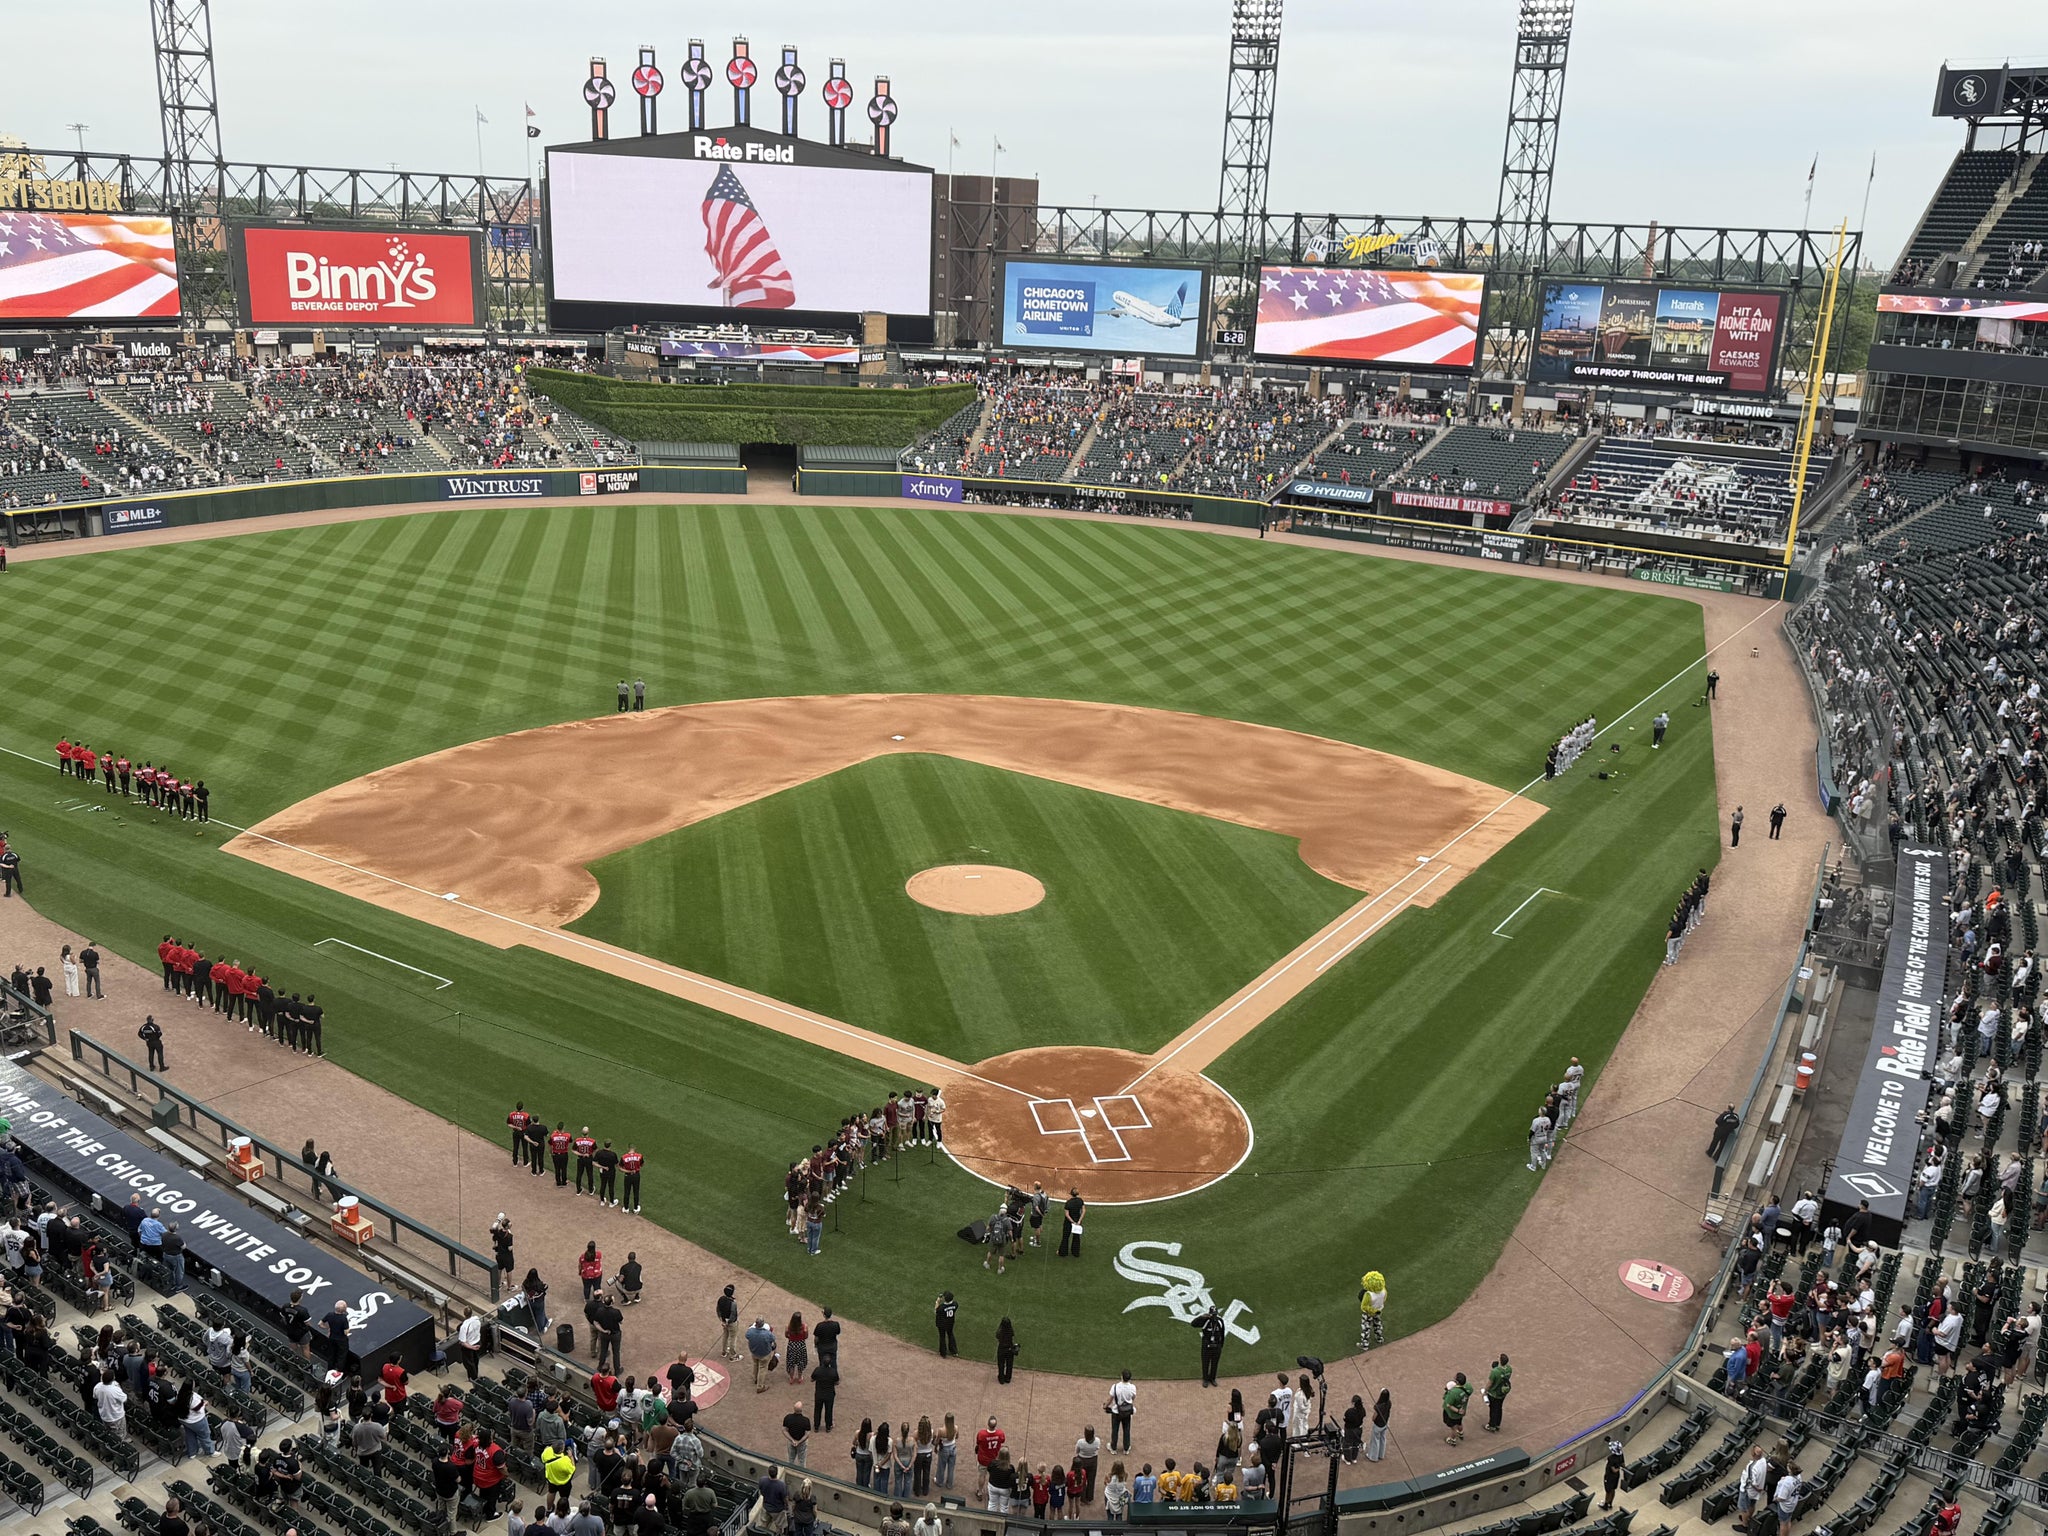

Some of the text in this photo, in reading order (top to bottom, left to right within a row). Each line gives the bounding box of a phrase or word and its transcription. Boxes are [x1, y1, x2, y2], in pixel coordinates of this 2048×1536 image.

[694, 135, 794, 163] Rate Field
[1343, 233, 1402, 260] Miller
[1389, 243, 1416, 256] TIME
[1023, 287, 1085, 300] CHICAGO'S
[291, 301, 379, 312] BEVERAGE DEPOT
[1023, 299, 1088, 312] HOMETOWN
[1617, 298, 1651, 306] HORSESHOE
[1671, 299, 1704, 311] Harrah's
[1022, 311, 1063, 322] AIRLINE
[1732, 306, 1762, 317] HIT A
[1720, 316, 1772, 332] HOME RUN
[1729, 331, 1758, 341] WITH
[131, 342, 171, 356] Modelo
[627, 343, 656, 354] FAN DECK
[1719, 350, 1760, 360] CAESARS
[862, 352, 884, 362] FAN DECK
[1574, 366, 1724, 385] GAVE PROOF THROUGH THE NIGHT
[1691, 399, 1773, 418] Lite LANDING
[598, 472, 638, 483] STREAM
[448, 477, 543, 495] WINTRUST
[607, 481, 630, 492] NOW
[910, 481, 953, 499] xfinity
[1075, 487, 1126, 500] THE PATIO
[1314, 486, 1367, 500] HYUNDAI
[1394, 492, 1459, 510] WHITTINGHAM
[1462, 499, 1494, 514] MEATS
[130, 508, 161, 520] MLB+
[1481, 547, 1503, 560] Rate
[1651, 571, 1680, 585] RUSH
[1902, 860, 1931, 998] HOME OF THE CHICAGO WHITE SOX
[1876, 999, 1931, 1080] Rate Field
[1863, 1080, 1905, 1166] WELCOME TO
[252, 1169, 260, 1179] G
[29, 1111, 69, 1129] OF
[56, 1127, 107, 1157] THE
[95, 1153, 197, 1213] CHICAGO
[190, 1209, 278, 1263] WHITE
[268, 1258, 333, 1296] SOX
[362, 1231, 370, 1241] G
[1666, 1275, 1684, 1299] TOYOTA
[624, 1398, 637, 1409] 23
[987, 1440, 998, 1450] 17
[1476, 1457, 1495, 1467] PLEASE
